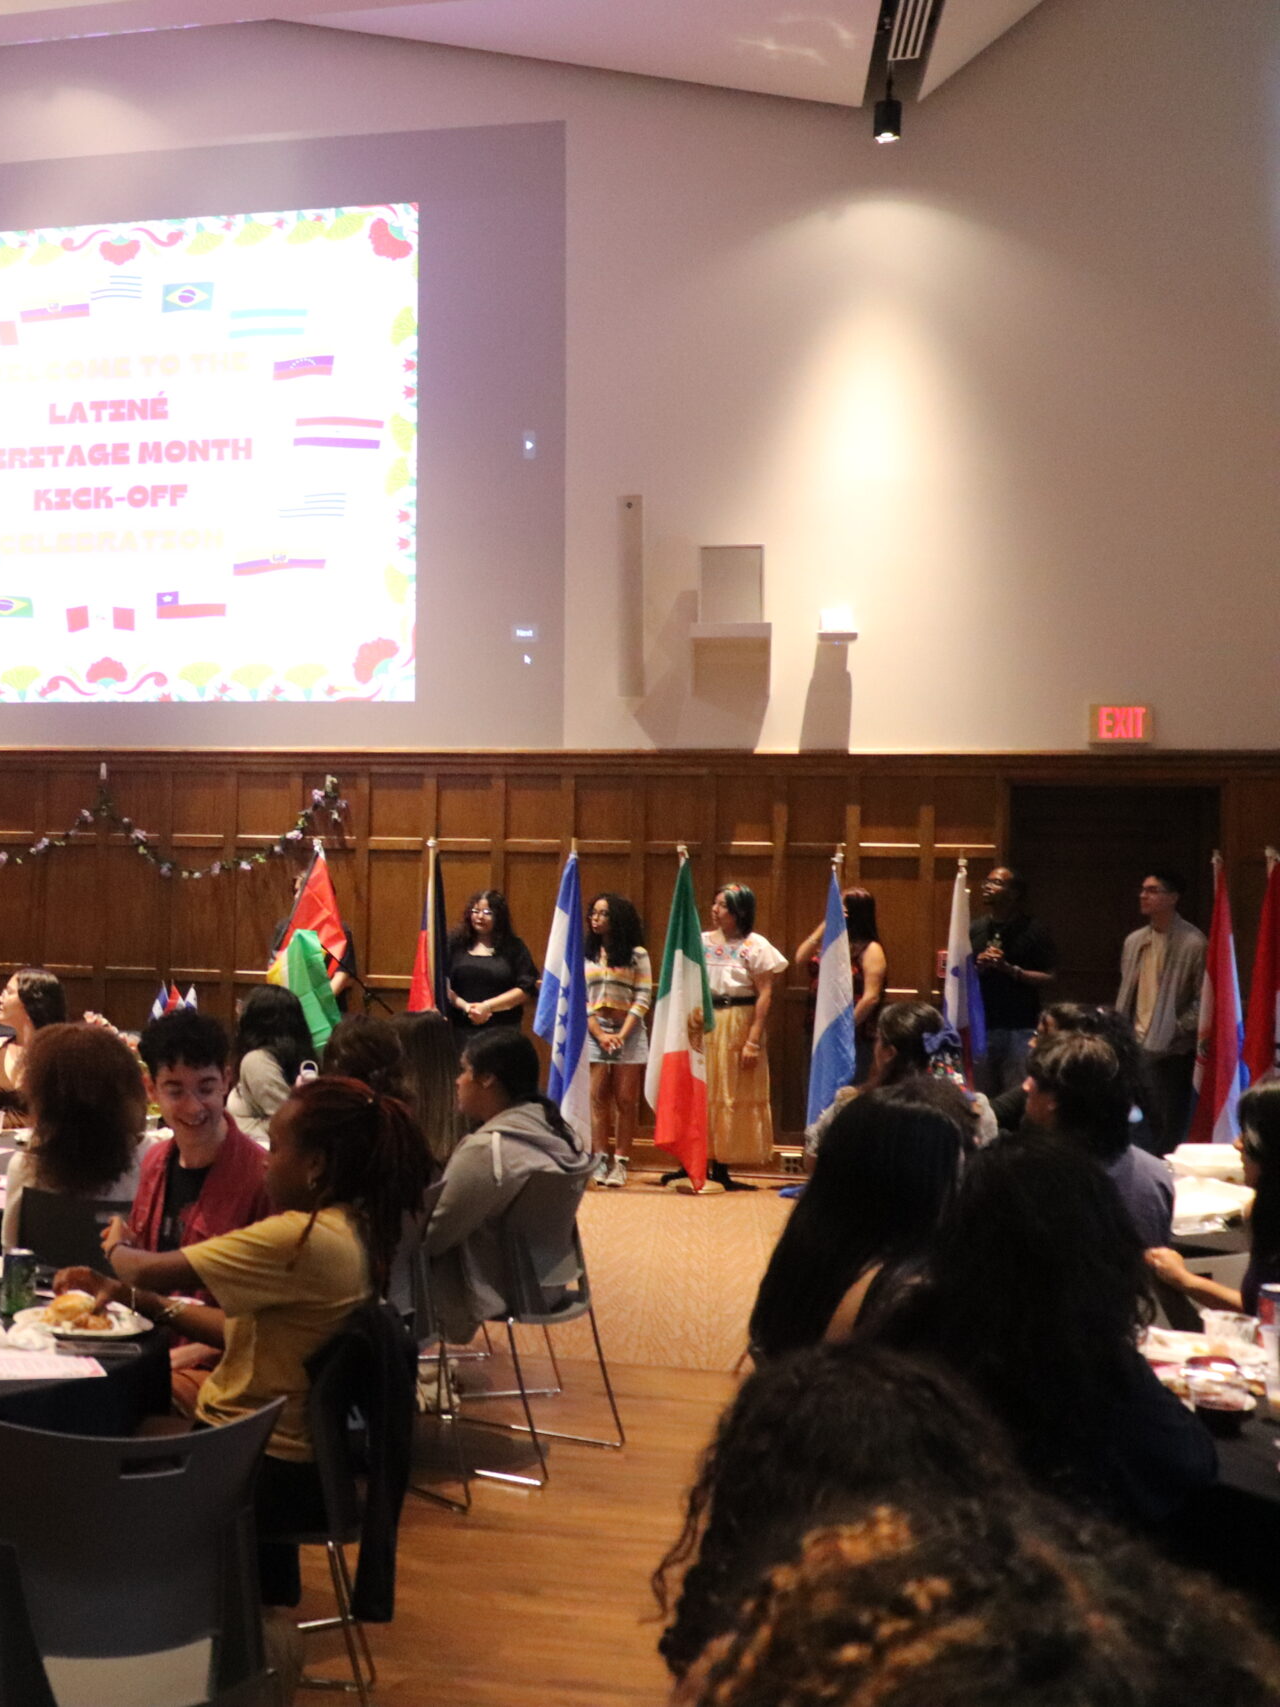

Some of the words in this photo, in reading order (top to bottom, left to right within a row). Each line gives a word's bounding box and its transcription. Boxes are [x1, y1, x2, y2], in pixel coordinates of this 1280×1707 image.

[139, 353, 181, 377] TO
[190, 351, 250, 374] THE
[49, 391, 168, 424] LATINÉ
[137, 438, 253, 465] MONTH
[33, 484, 188, 511] KICK-OFF
[1099, 706, 1146, 738] EXIT
